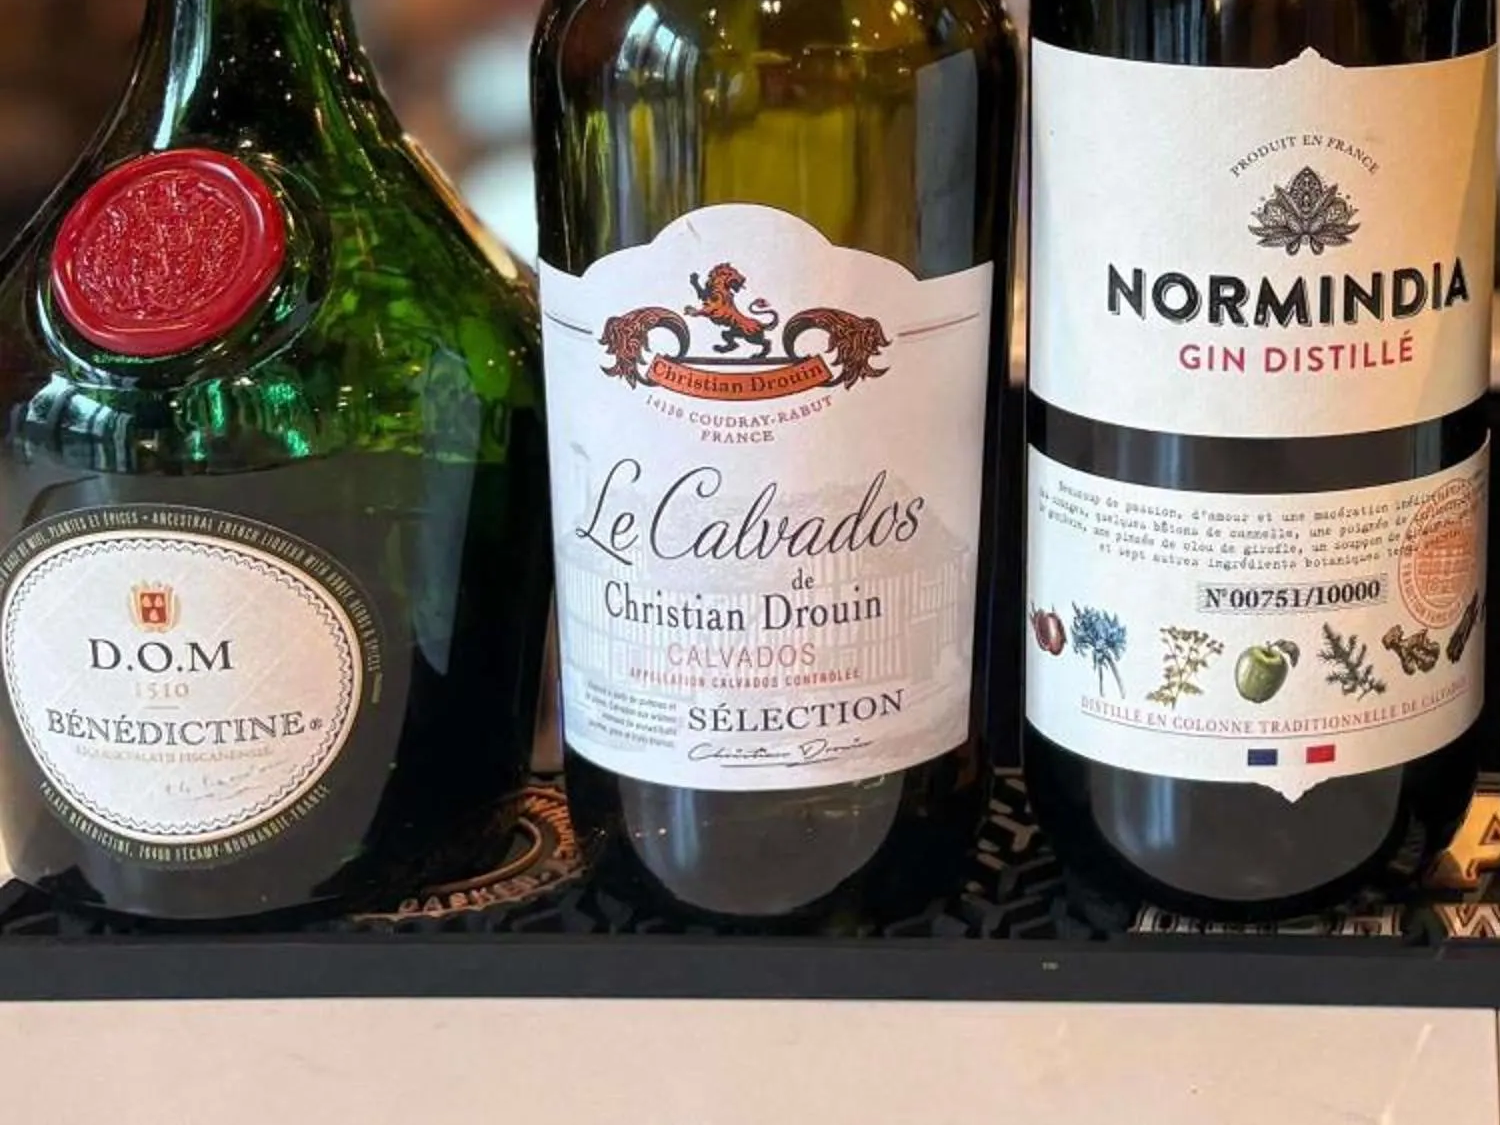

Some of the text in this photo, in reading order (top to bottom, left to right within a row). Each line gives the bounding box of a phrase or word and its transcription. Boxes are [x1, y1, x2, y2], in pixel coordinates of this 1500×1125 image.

[1229, 134, 1381, 178] PRODUIT EN FRANCE
[1106, 255, 1472, 330] NORMINDIA
[1178, 330, 1415, 375] GIN DISTILLÉ
[651, 358, 824, 394] Christian Drouin
[700, 430, 776, 445] FRANCE
[575, 457, 927, 567] Le Calvados
[791, 568, 815, 592] de
[604, 579, 883, 632] Christian Drouin
[87, 638, 235, 674] D.O.M
[667, 642, 817, 669] CALVADOS
[711, 676, 779, 690] CALVADOS
[45, 707, 307, 746] BÉNÉDICTINE
[687, 688, 906, 733] SÉLECTION
[1147, 700, 1418, 734] EN COLONNE TRADITIONNELLE DE
